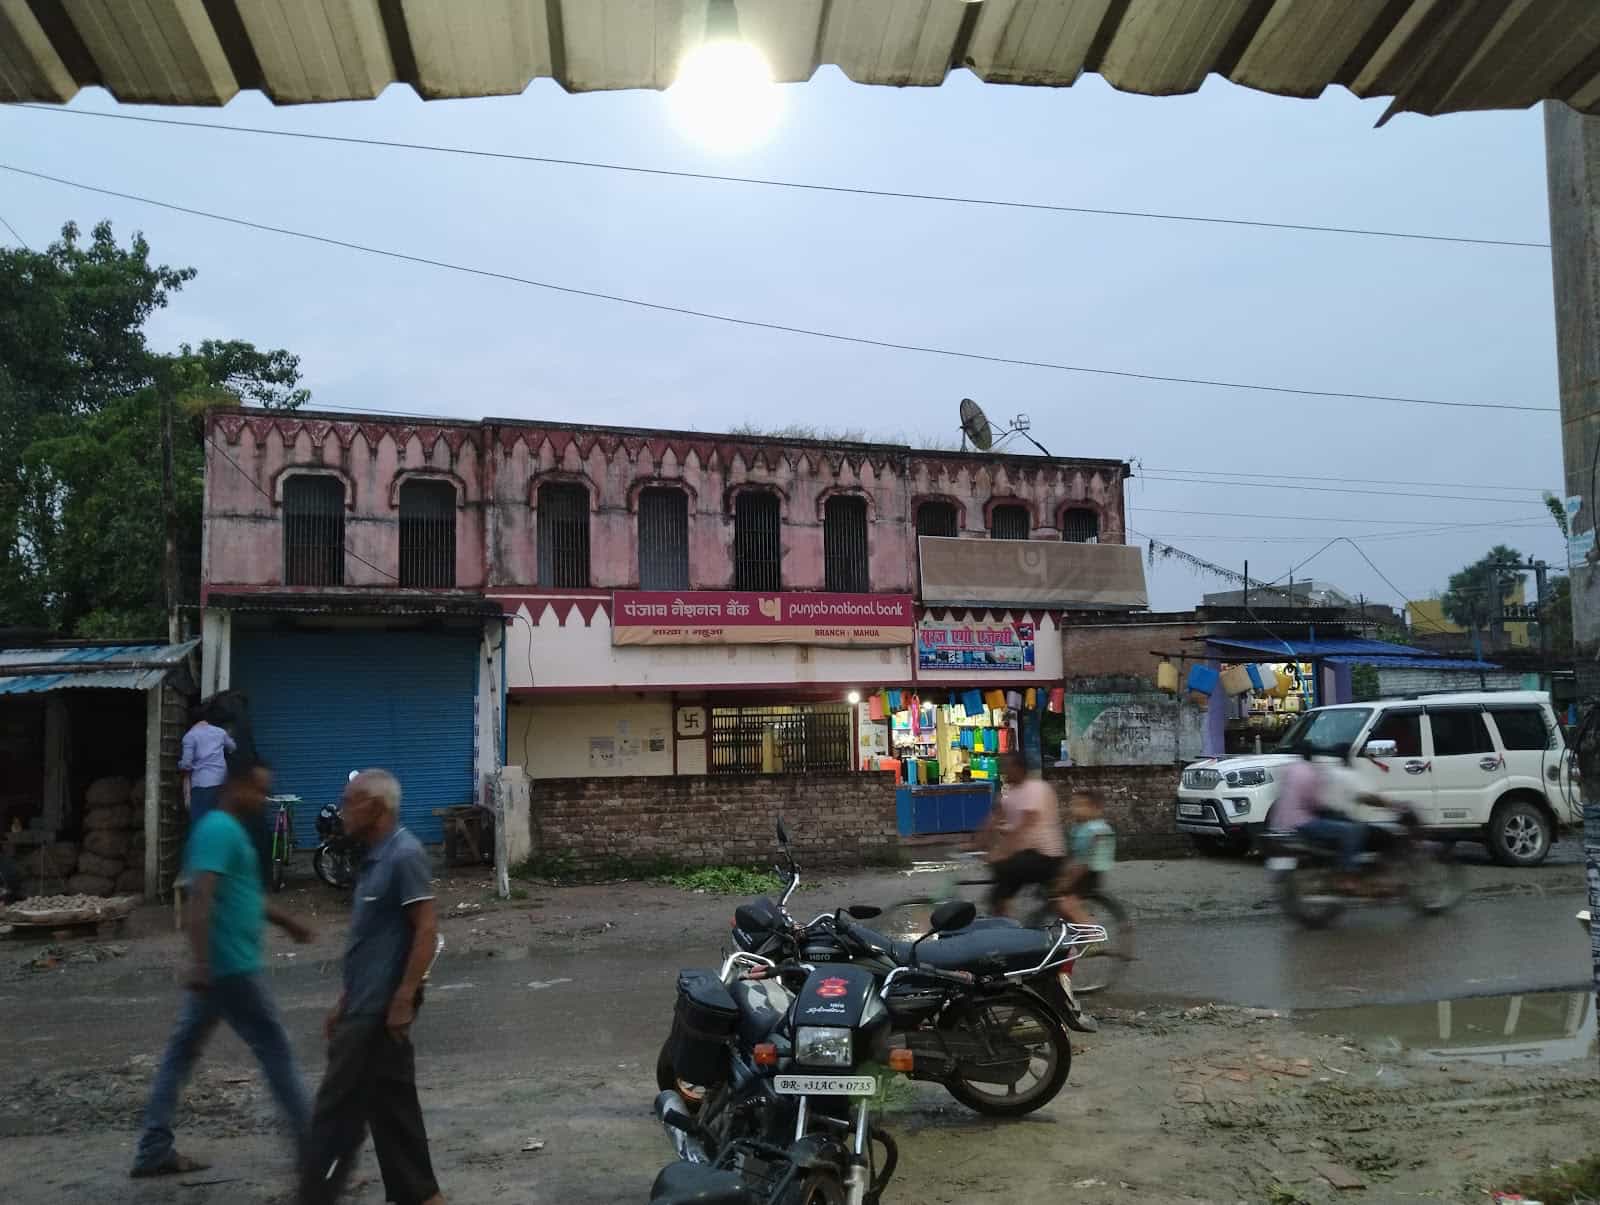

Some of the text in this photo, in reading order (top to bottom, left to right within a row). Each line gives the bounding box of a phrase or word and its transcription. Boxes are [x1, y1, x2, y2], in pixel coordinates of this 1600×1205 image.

[624, 598, 750, 618] पंजाब नैशनल बैंक
[789, 601, 903, 618] punjab national bank
[815, 629, 880, 637] BRANCH MAHUA
